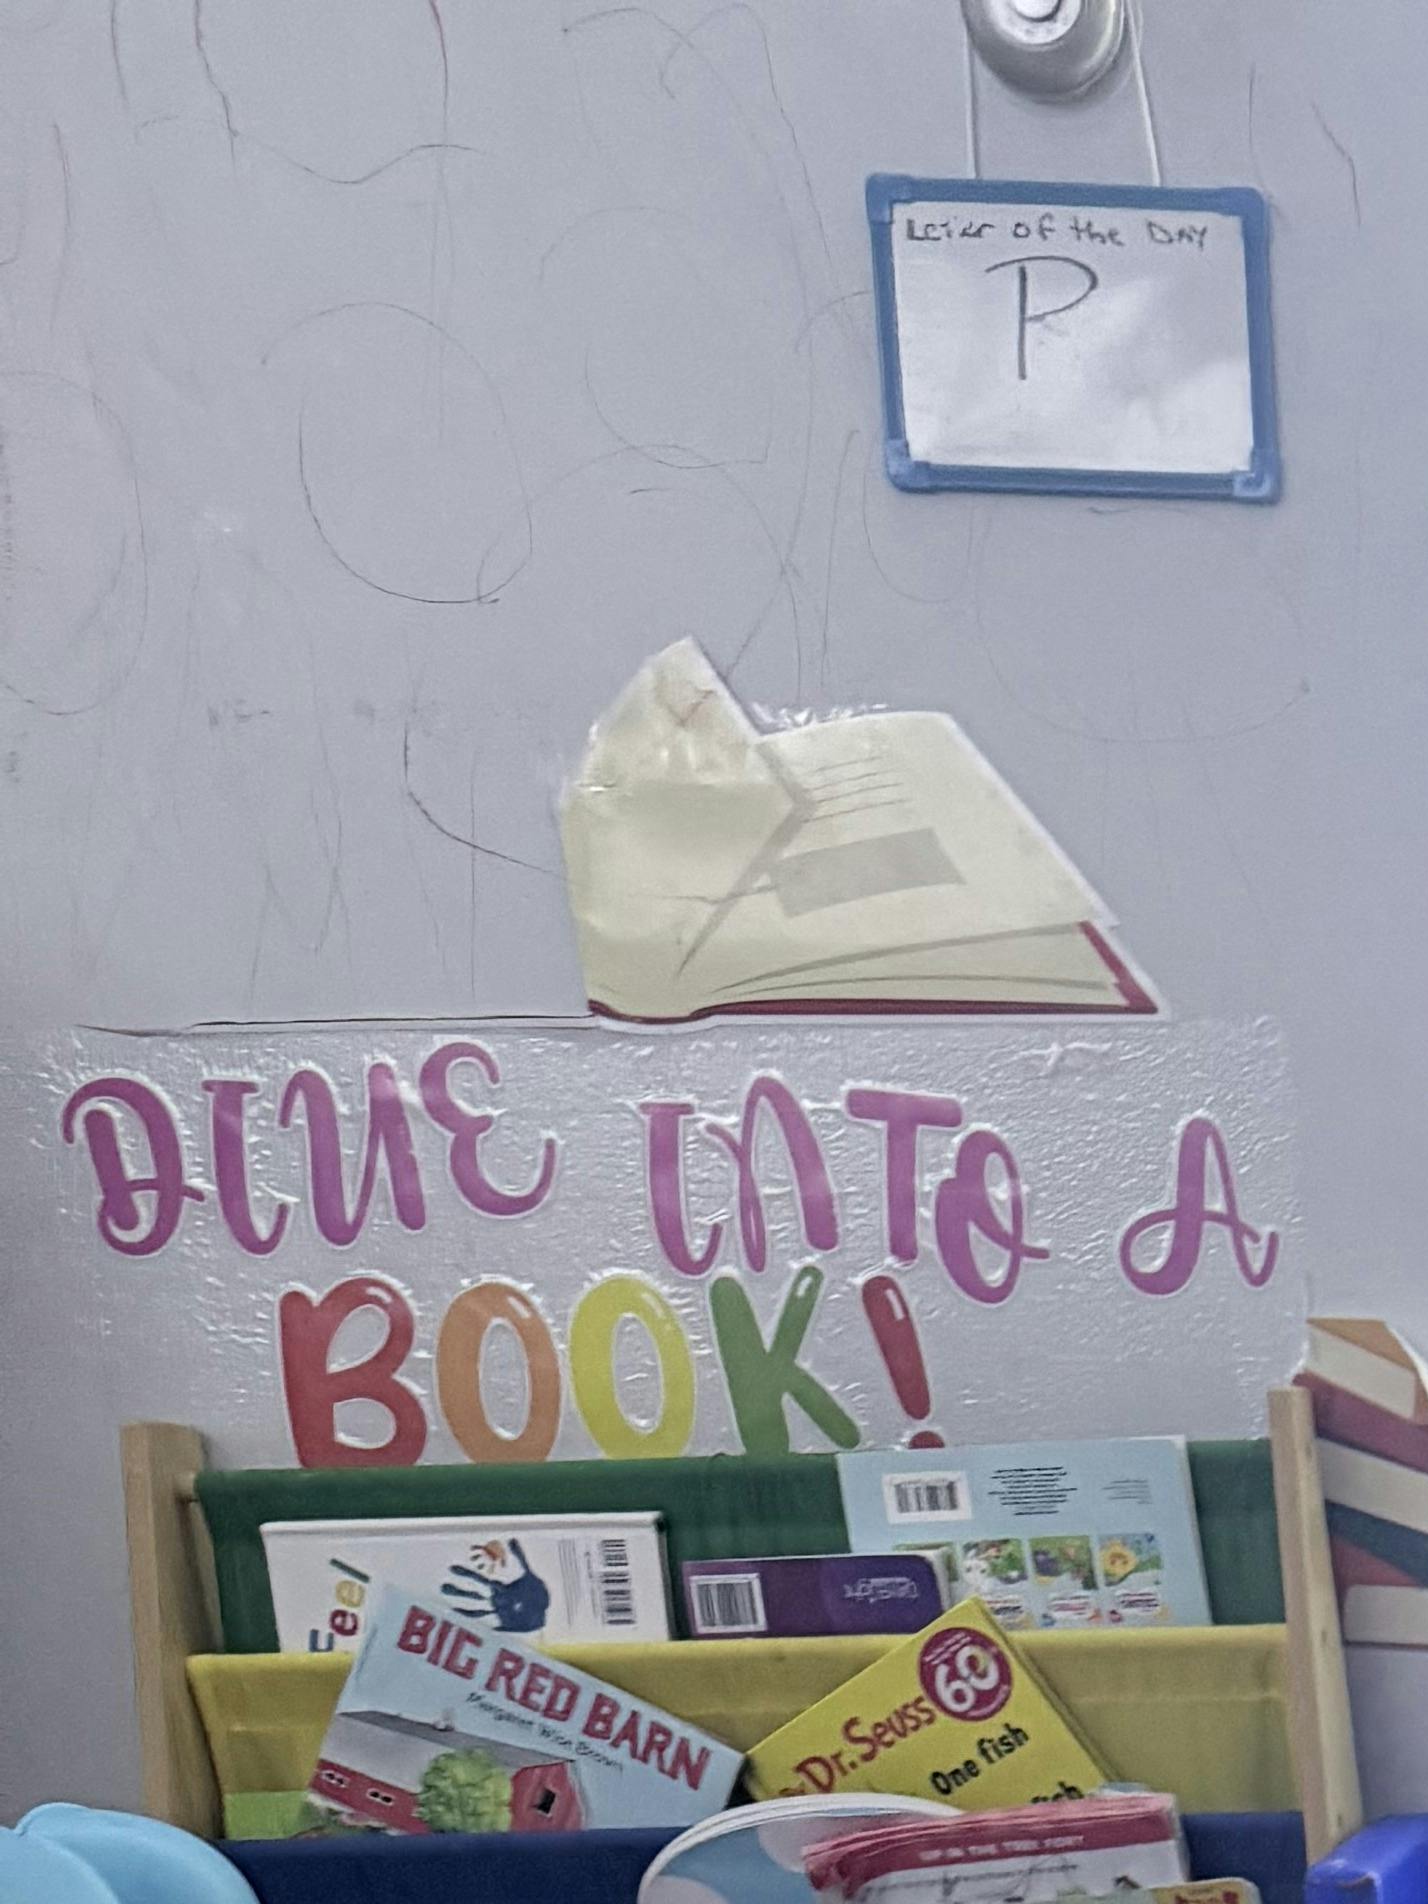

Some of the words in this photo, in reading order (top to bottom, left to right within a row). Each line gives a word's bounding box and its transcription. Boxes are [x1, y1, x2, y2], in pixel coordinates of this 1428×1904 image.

[1069, 216, 1126, 247] the
[984, 254, 1099, 380] P
[62, 1041, 559, 1257] DIVE
[638, 1075, 1051, 1304] INTO
[1119, 1117, 1280, 1296] A
[278, 1265, 946, 1468] BOOK!
[396, 1604, 484, 1681] BIG
[484, 1647, 581, 1723] RED
[581, 1692, 712, 1792] BARN
[934, 1644, 1001, 1713] 60
[792, 1749, 858, 1793] Dr.
[841, 1694, 938, 1764] Seuss
[930, 1758, 981, 1796] One
[976, 1722, 1031, 1765] fish
